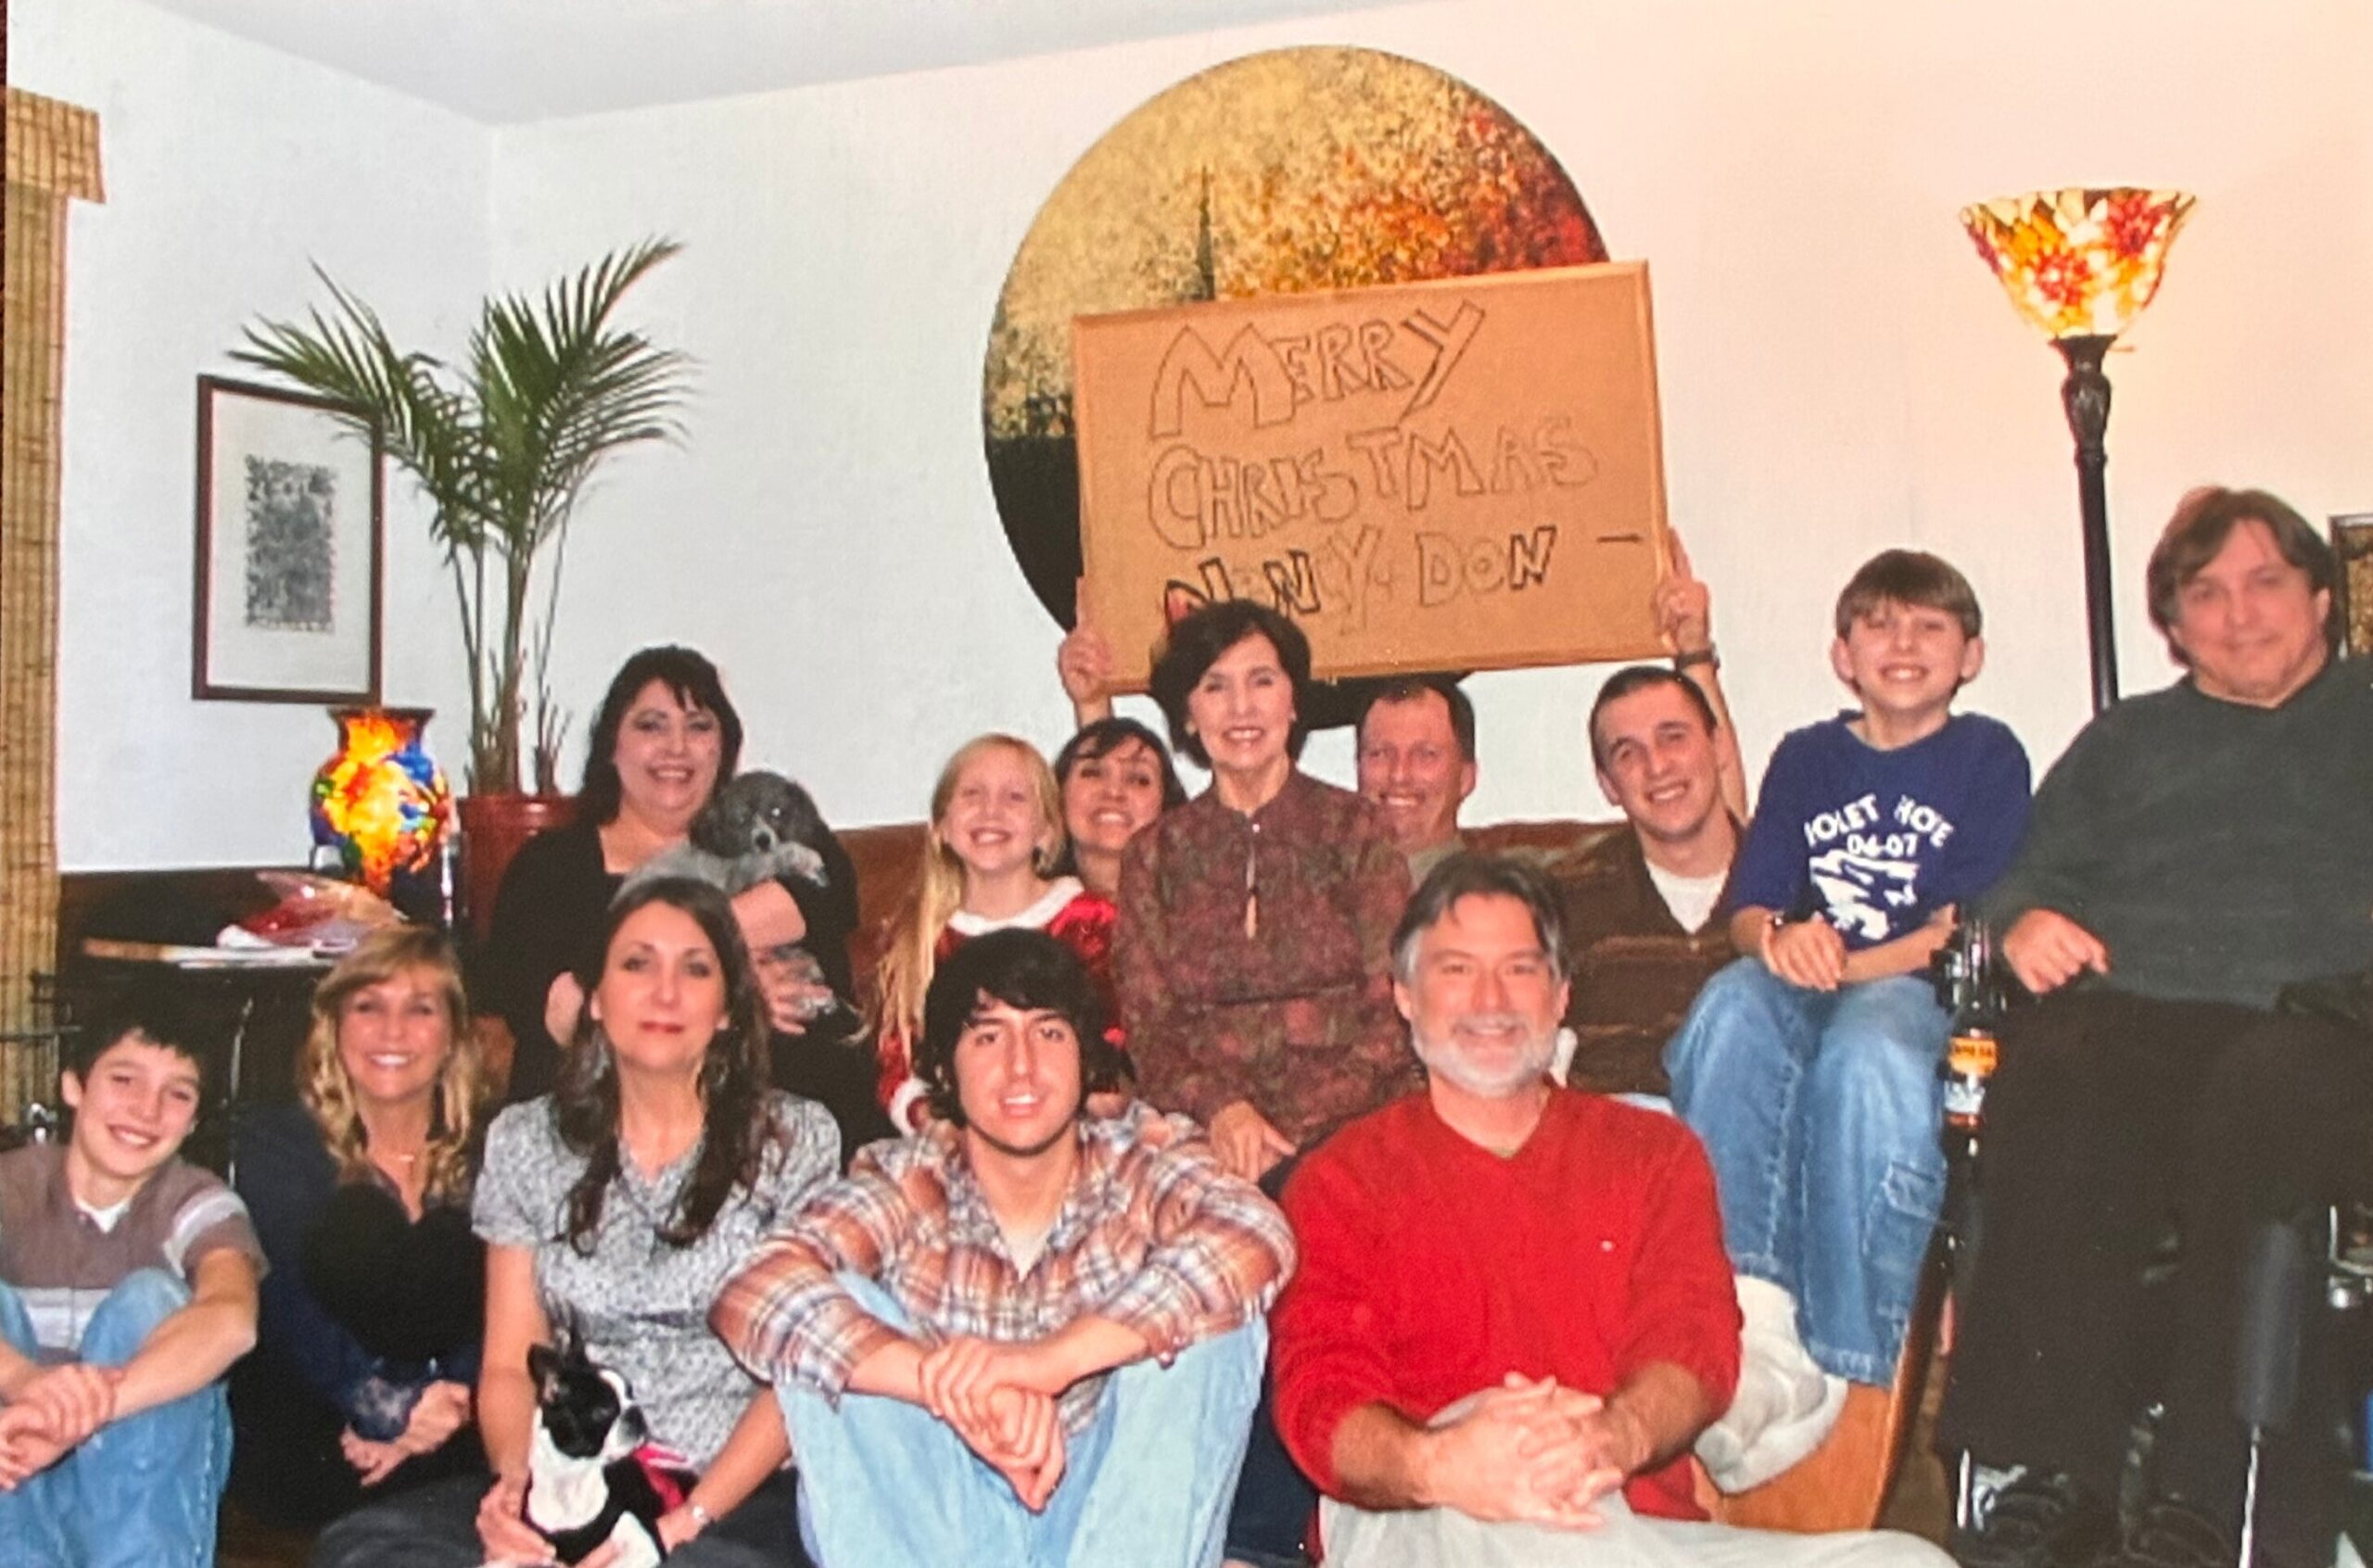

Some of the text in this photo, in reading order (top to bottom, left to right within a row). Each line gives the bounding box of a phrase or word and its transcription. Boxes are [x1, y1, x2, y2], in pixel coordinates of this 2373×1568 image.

[1149, 299, 1486, 439] MERRY
[1148, 417, 1599, 550] CHRISTMAS
[1415, 526, 1557, 607] DON
